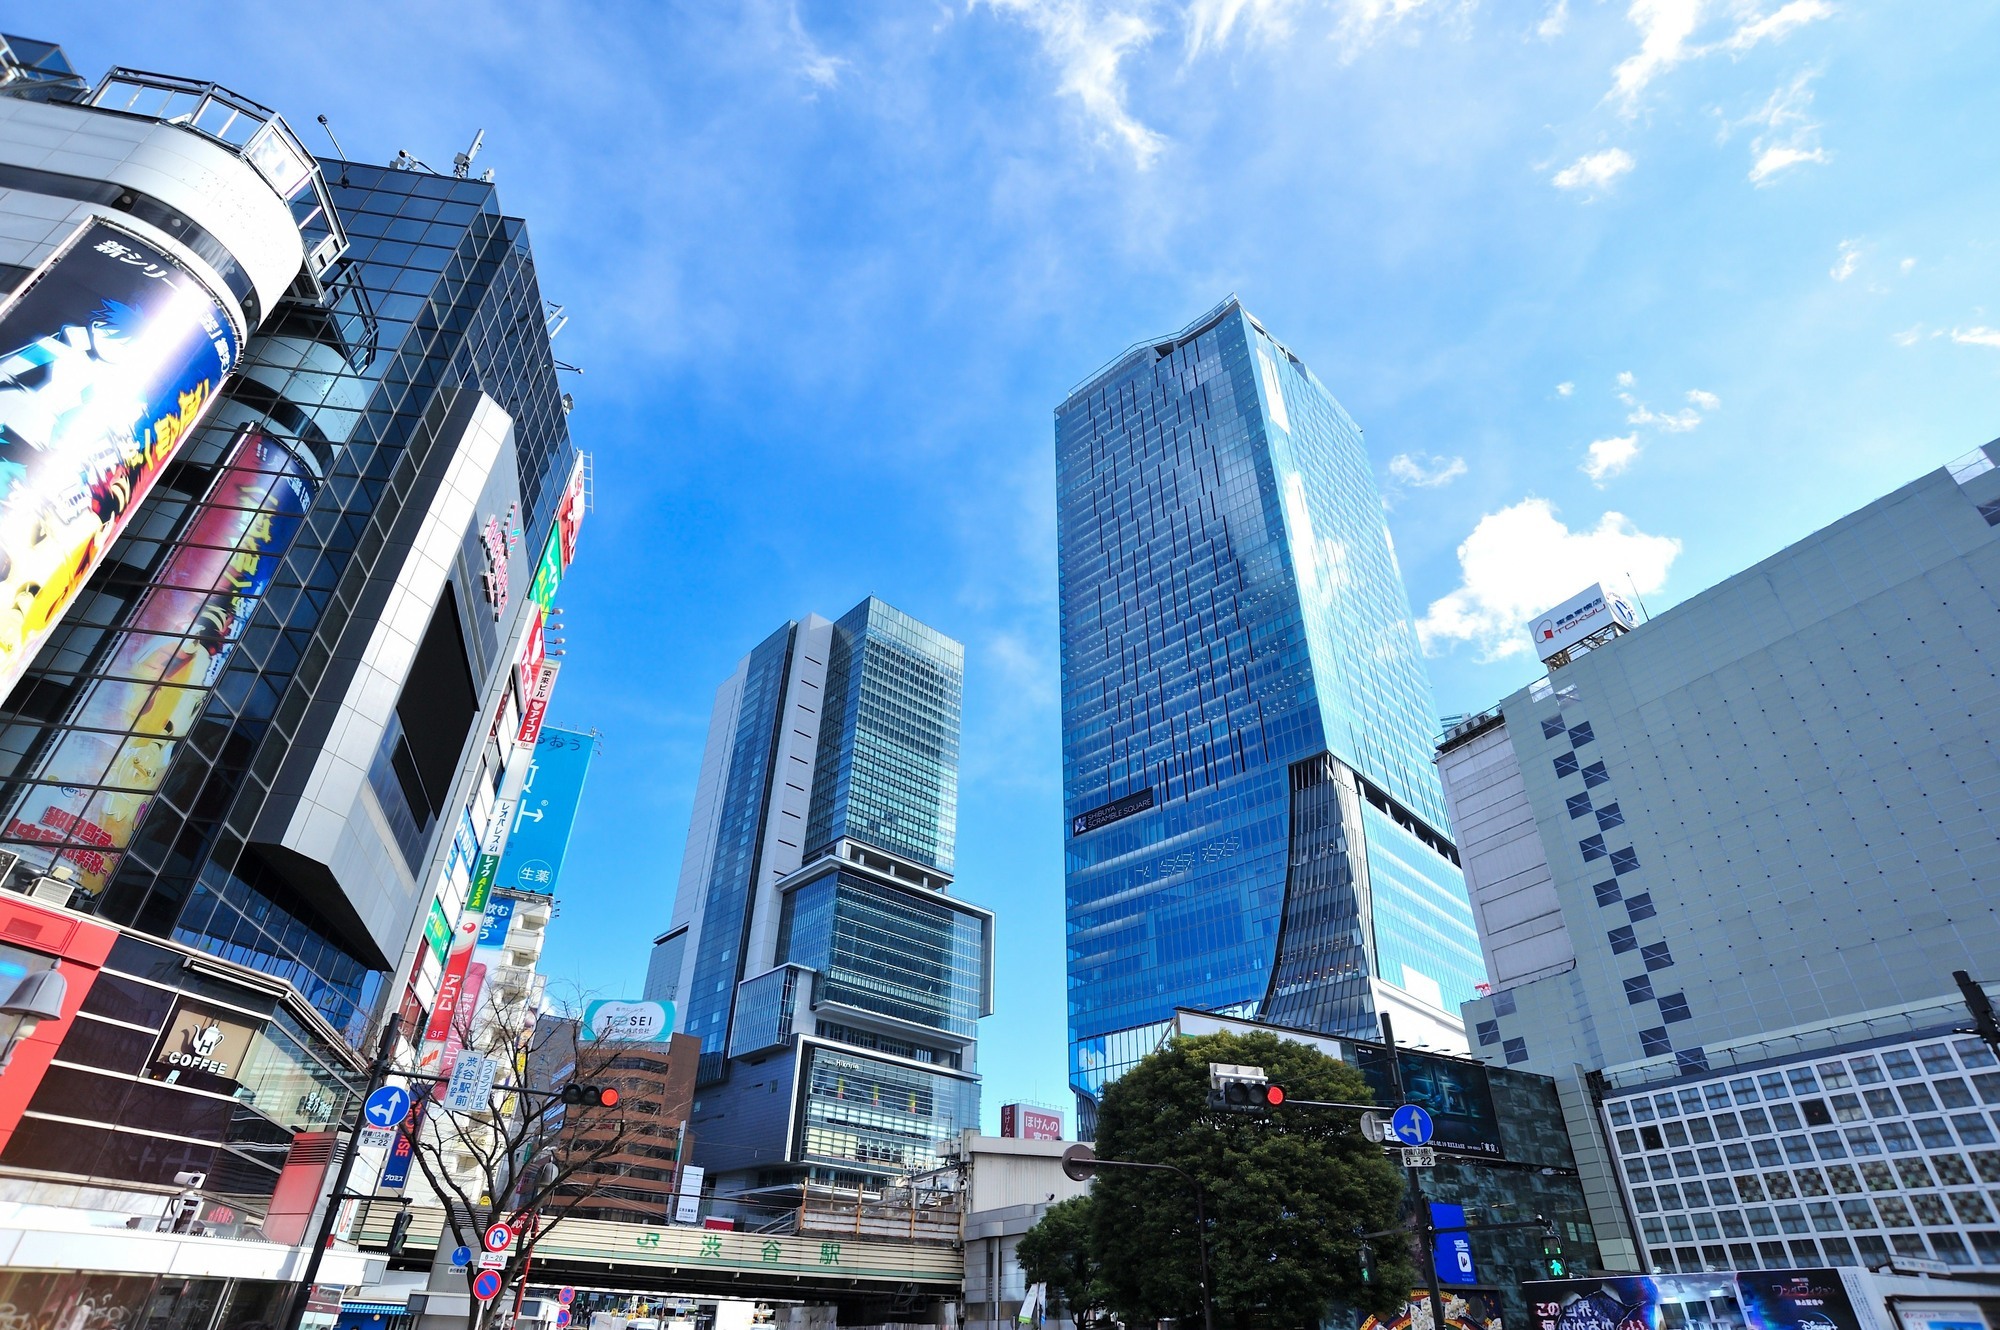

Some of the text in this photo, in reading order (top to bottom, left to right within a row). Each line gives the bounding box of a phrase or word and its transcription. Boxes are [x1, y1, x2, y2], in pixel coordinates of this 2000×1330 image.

[1554, 603, 1607, 634] TOKYU
[1555, 597, 1603, 627] 東急東横店
[521, 709, 541, 741] アイフル
[1087, 804, 1117, 820] SHIBUYA
[1087, 798, 1152, 829] SCRAMBLE SQUARE
[480, 854, 496, 877] レイク
[519, 867, 551, 884] 生薬
[471, 877, 488, 907] ALSA
[438, 973, 461, 1011] アコム
[430, 1030, 444, 1039] 3F
[168, 1051, 229, 1075] COFFEE
[452, 1062, 465, 1086] Shibuya
[455, 1056, 479, 1107] 渋谷駅前
[474, 1061, 494, 1109] スクランブル式
[1025, 1115, 1059, 1132] ほけんの
[1405, 1156, 1432, 1166] 8-22
[384, 1174, 403, 1182] プロミス
[636, 1232, 842, 1266] JR 渋谷駅
